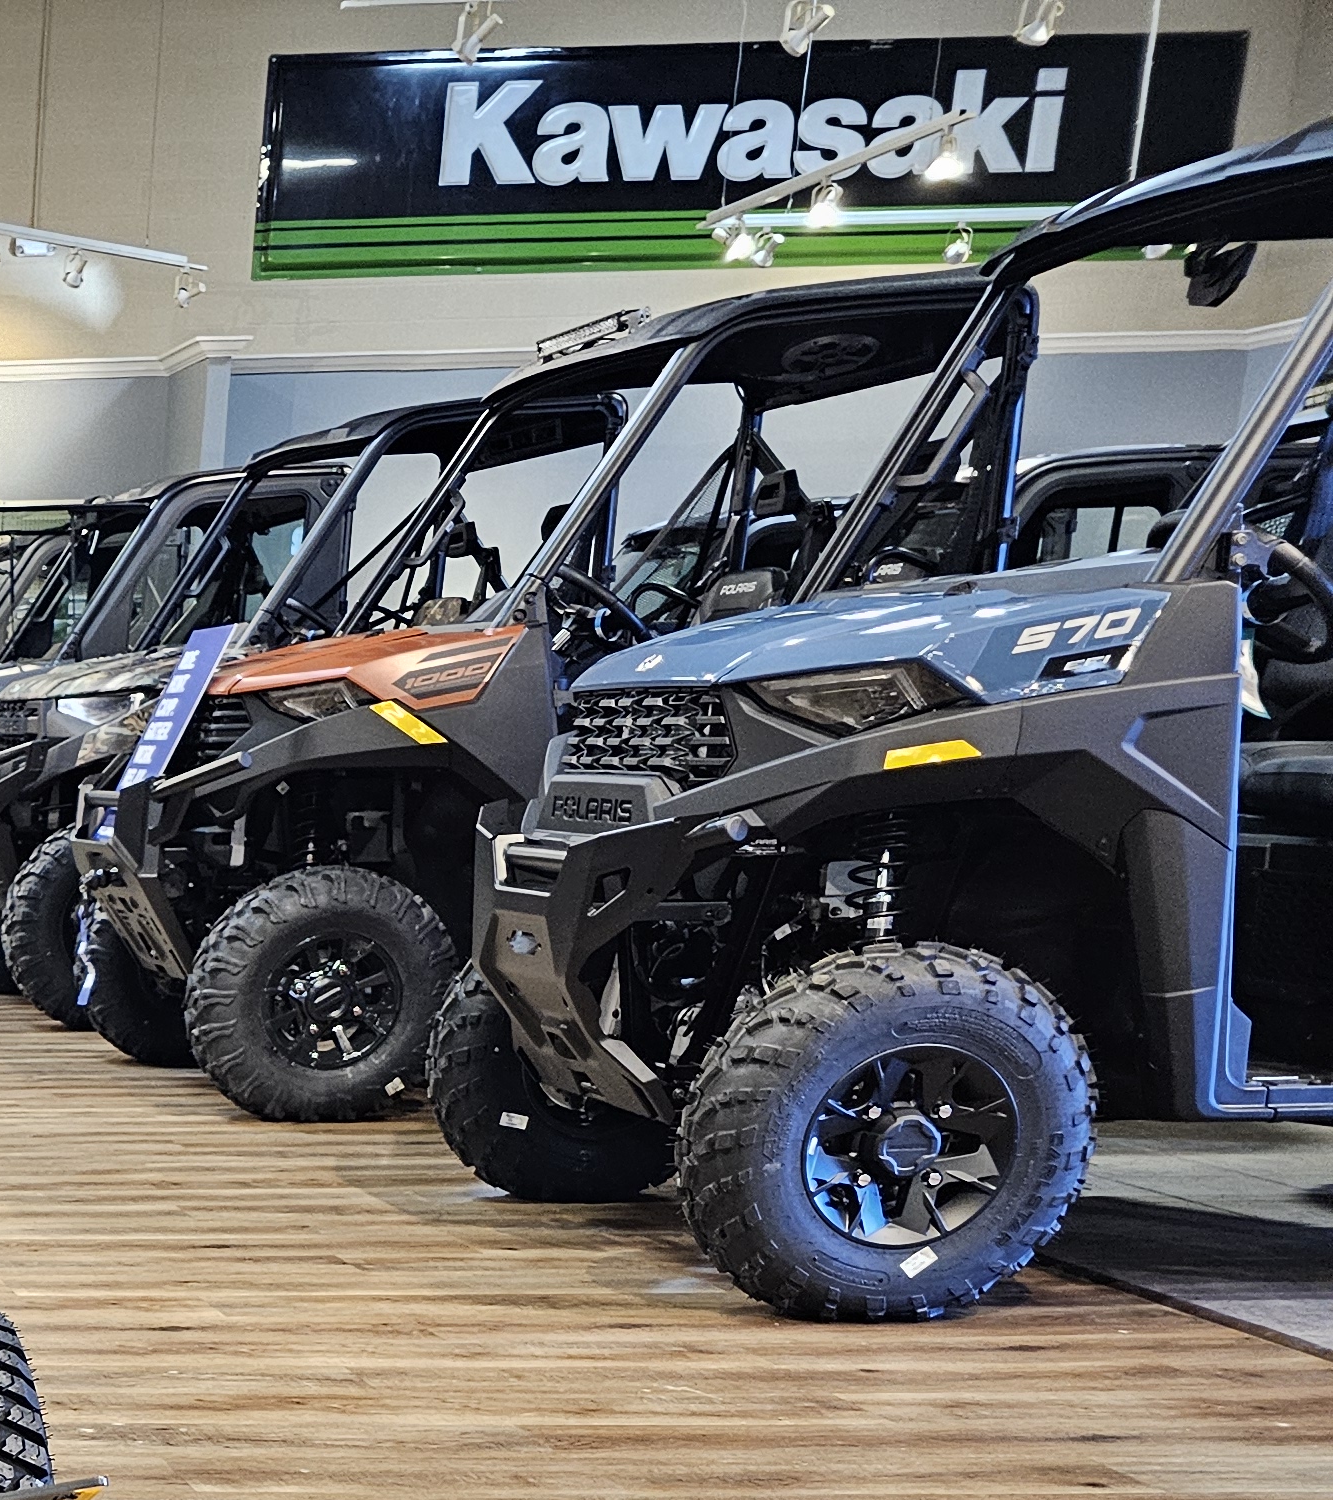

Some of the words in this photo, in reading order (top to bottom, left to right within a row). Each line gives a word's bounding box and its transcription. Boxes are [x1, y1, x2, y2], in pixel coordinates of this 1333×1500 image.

[438, 67, 1069, 187] Kawasaki
[720, 581, 758, 596] POLARIS
[1011, 607, 1142, 655] 570
[404, 662, 492, 690] 1000
[551, 795, 633, 825] POLARIS
